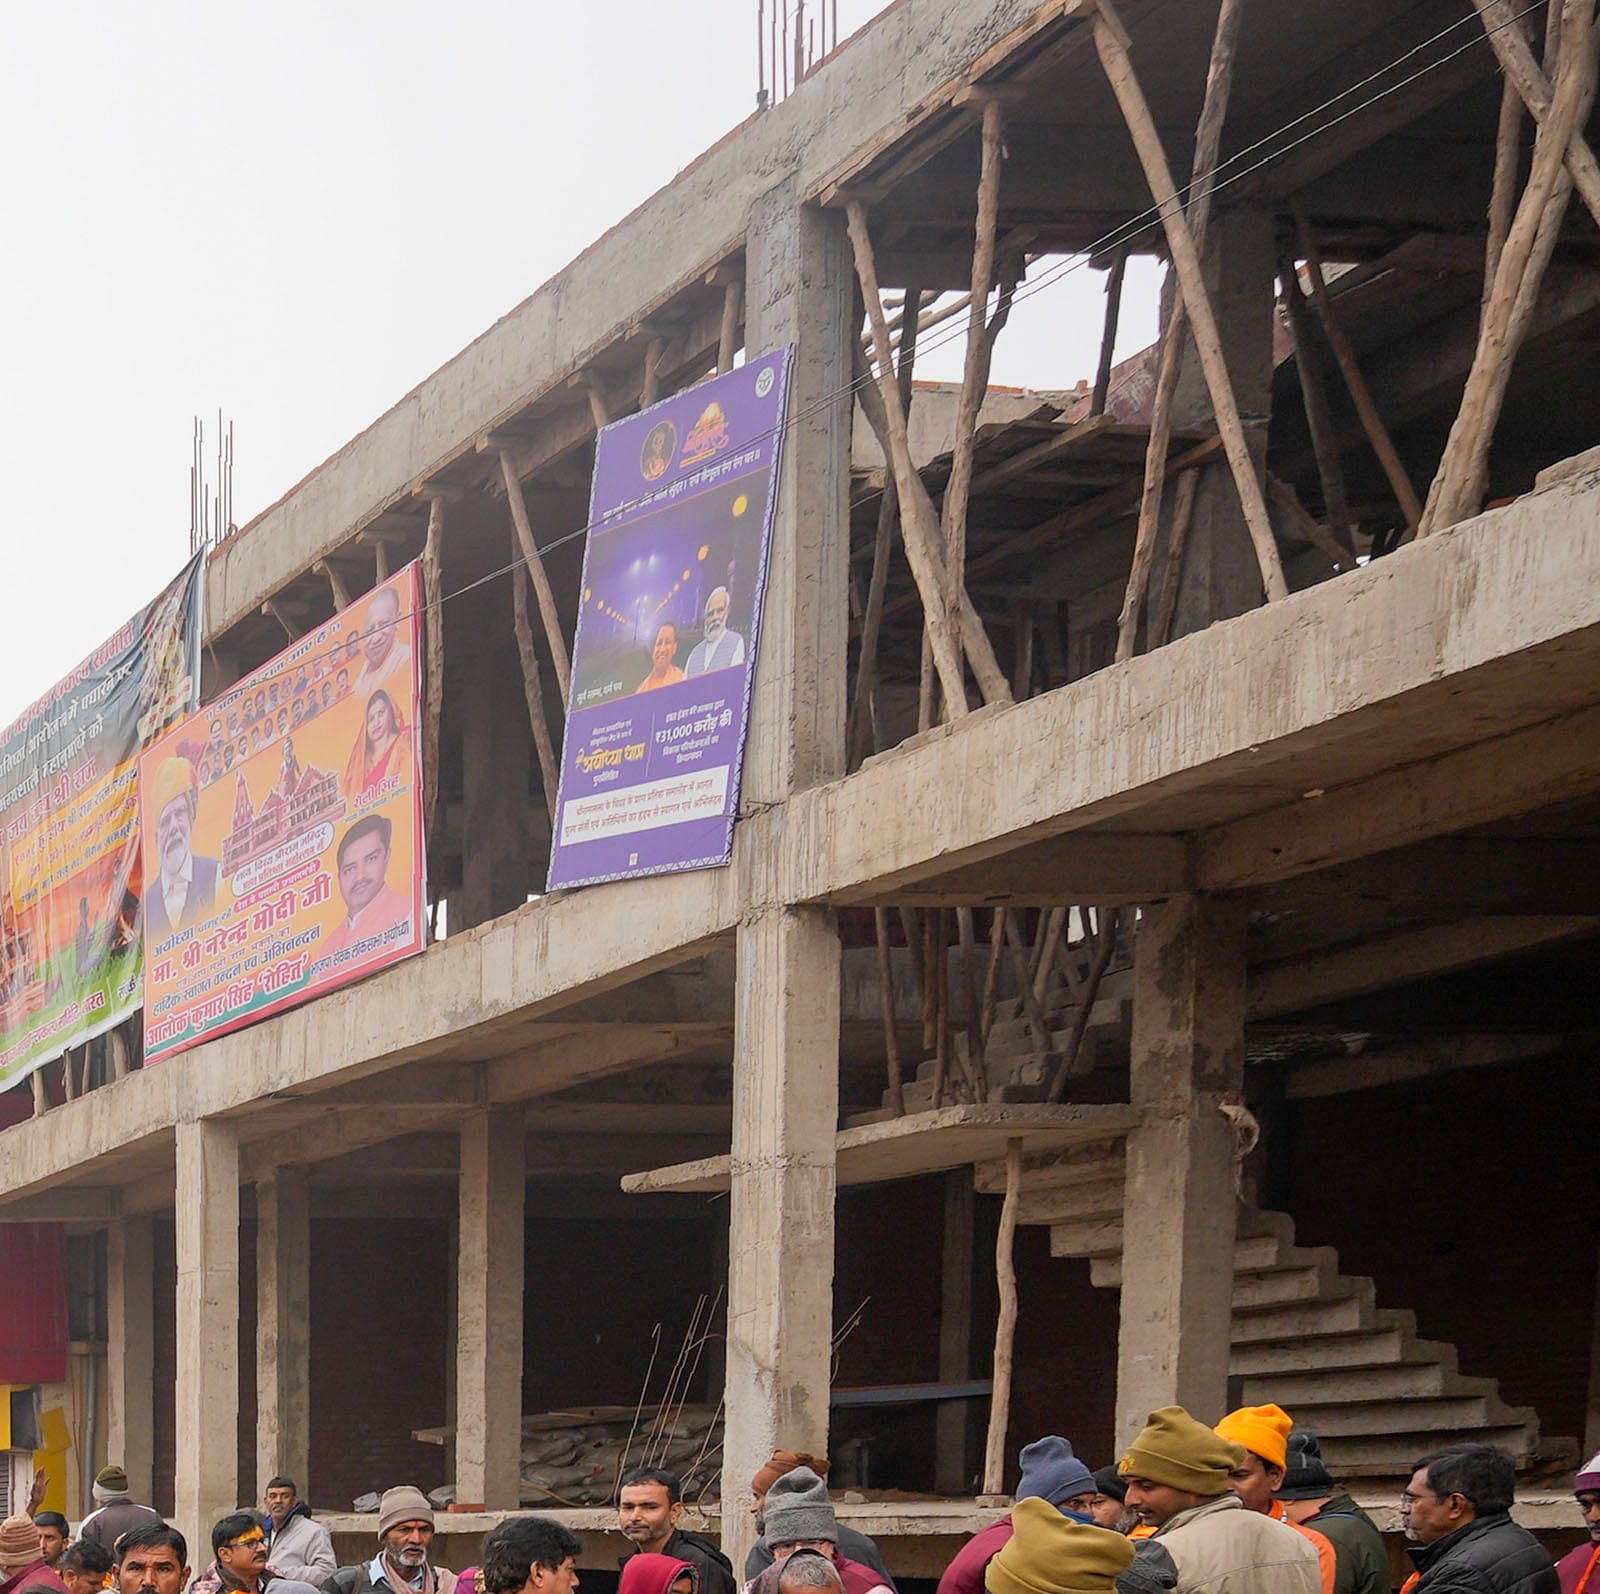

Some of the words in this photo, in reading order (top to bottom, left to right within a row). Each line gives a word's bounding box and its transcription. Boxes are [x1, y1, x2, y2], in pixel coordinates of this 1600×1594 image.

[719, 707, 733, 728] की
[583, 744, 622, 775] अयोध्या
[624, 741, 646, 762] धाम
[53, 773, 74, 809] श्री
[181, 939, 204, 971] श्री
[206, 914, 250, 958] नरेन्द्र
[252, 888, 298, 932] मोदी
[302, 871, 333, 910] जी
[154, 924, 195, 957] अयोध्या
[260, 924, 323, 964] अभिनन्दन
[146, 1010, 189, 1048] आलोक
[190, 995, 225, 1032] कुमार
[226, 979, 254, 1012] सिंह
